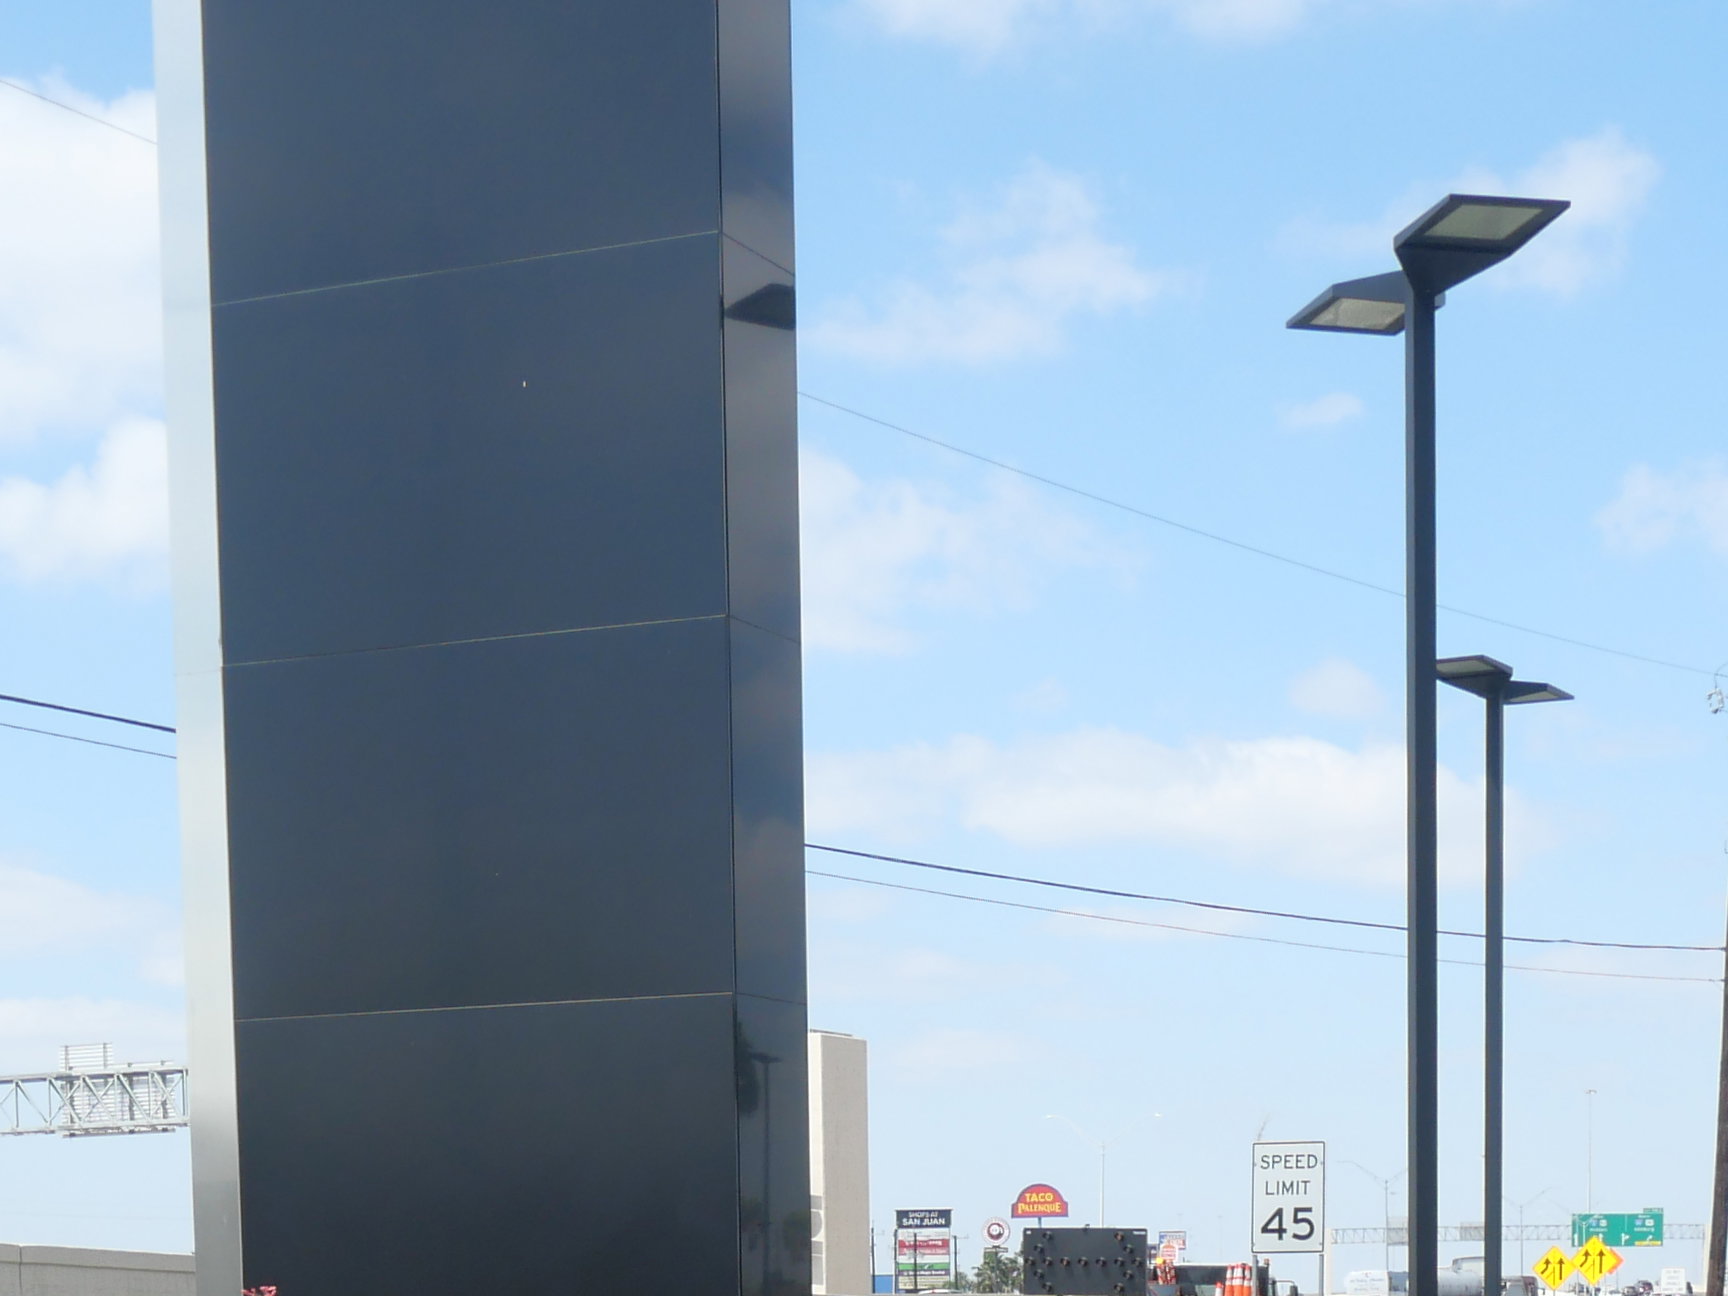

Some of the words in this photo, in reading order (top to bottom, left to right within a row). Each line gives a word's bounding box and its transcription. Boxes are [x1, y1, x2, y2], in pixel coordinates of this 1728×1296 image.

[1260, 1154, 1318, 1169] SPEED
[1265, 1180, 1311, 1195] LIMIT
[1025, 1193, 1053, 1202] TACO
[1018, 1202, 1062, 1214] PALENQUE
[903, 1218, 920, 1226] SAN
[923, 1218, 945, 1226] JUAN
[1261, 1207, 1315, 1241] 45
